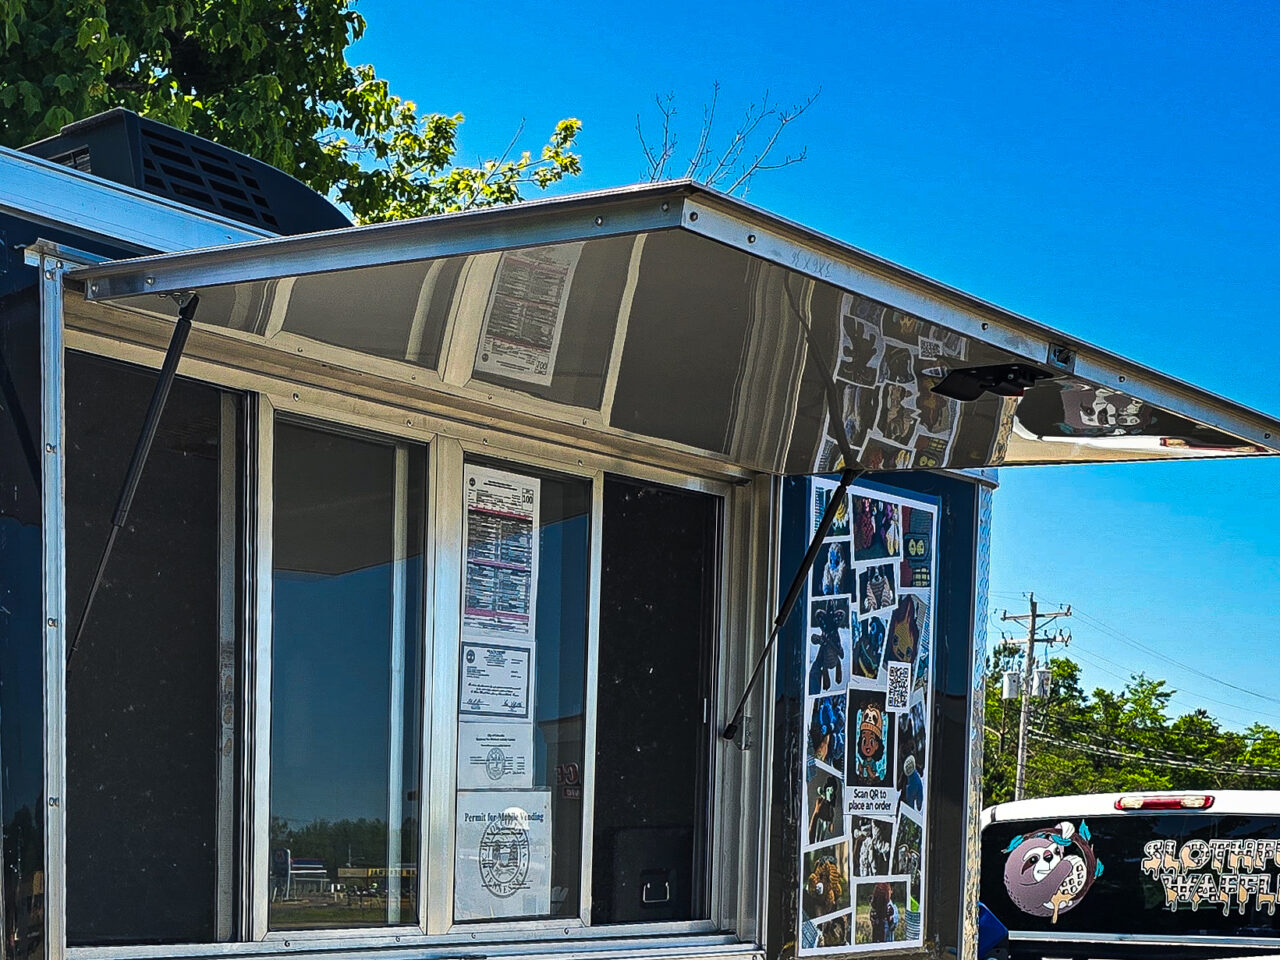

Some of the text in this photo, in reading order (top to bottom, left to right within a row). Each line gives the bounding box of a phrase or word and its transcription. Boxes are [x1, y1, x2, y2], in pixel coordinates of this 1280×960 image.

[522, 494, 534, 504] 100
[853, 788, 887, 800] Scan QR to
[849, 800, 891, 812] place an order
[464, 812, 486, 822] Permit
[487, 812, 497, 822] for
[1141, 839, 1280, 880] SLOTHF
[1161, 873, 1280, 917] WAFFL
